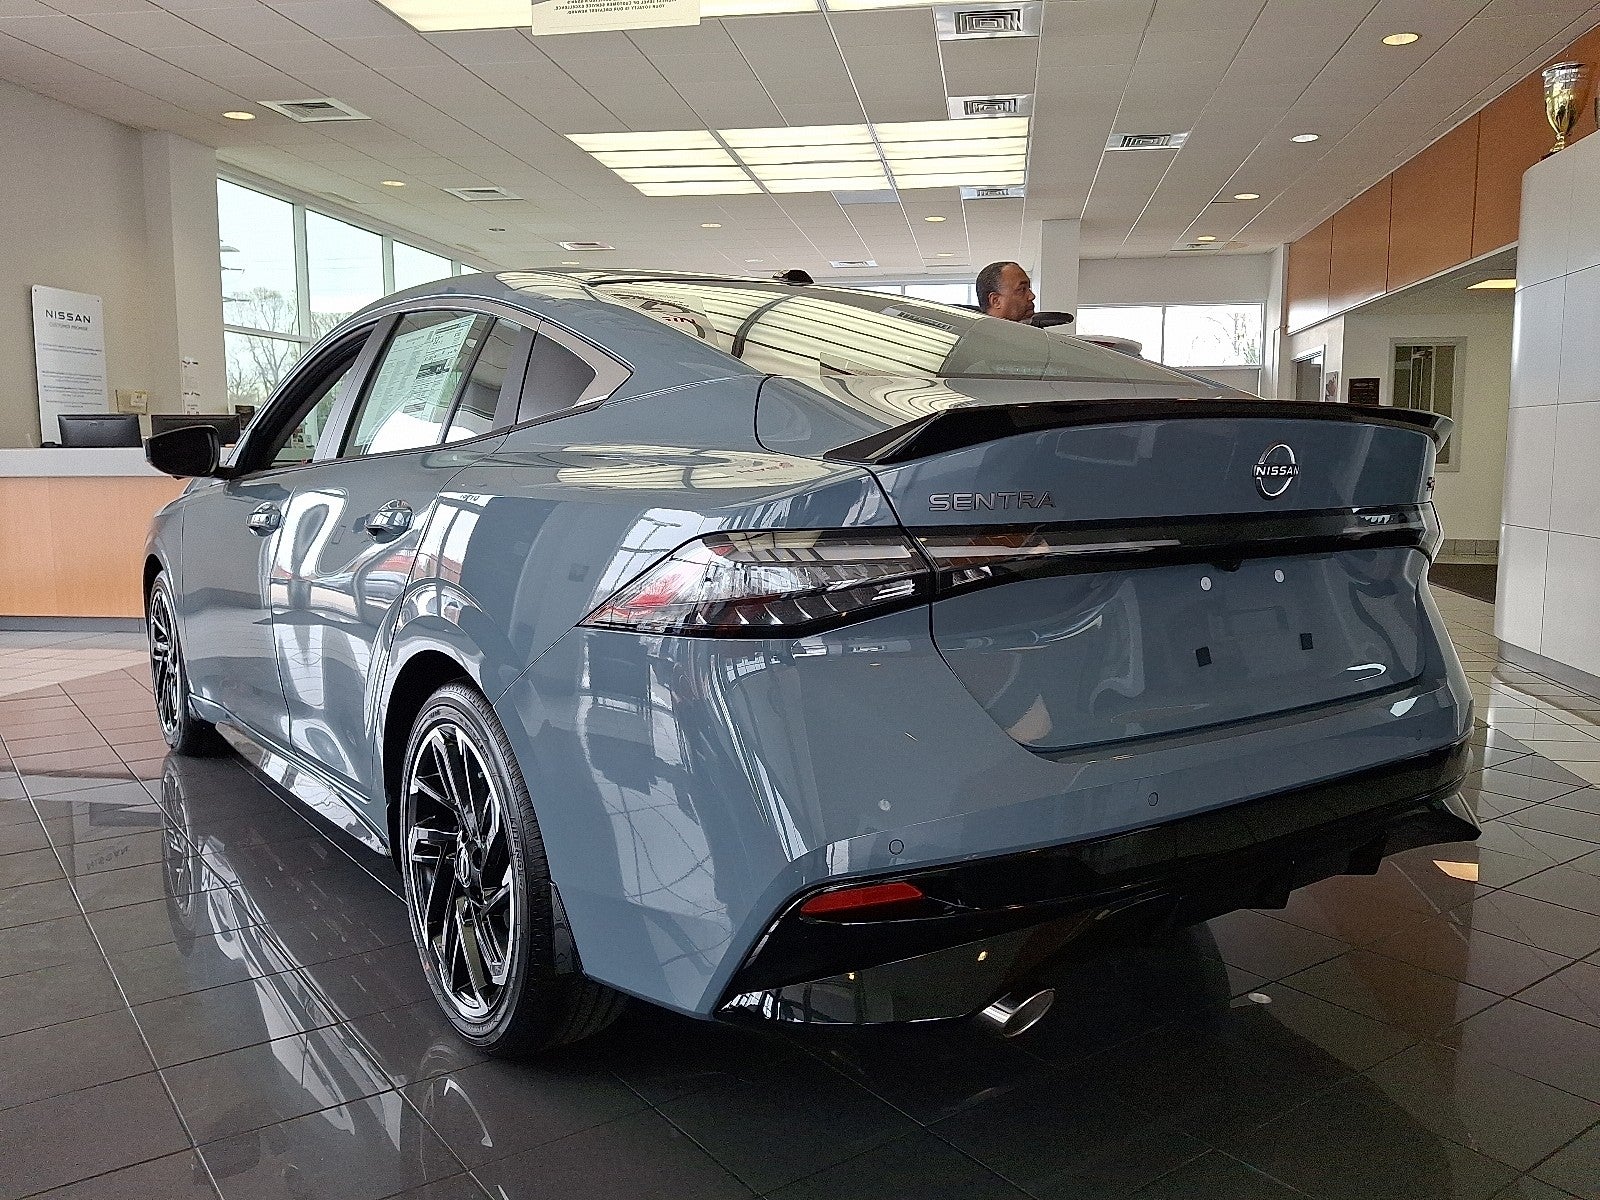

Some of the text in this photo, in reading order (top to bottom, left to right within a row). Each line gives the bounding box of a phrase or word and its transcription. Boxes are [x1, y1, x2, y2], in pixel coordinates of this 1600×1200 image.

[46, 309, 91, 323] NISSAN
[1255, 466, 1300, 476] NISSAN
[928, 491, 1057, 511] SENTRA
